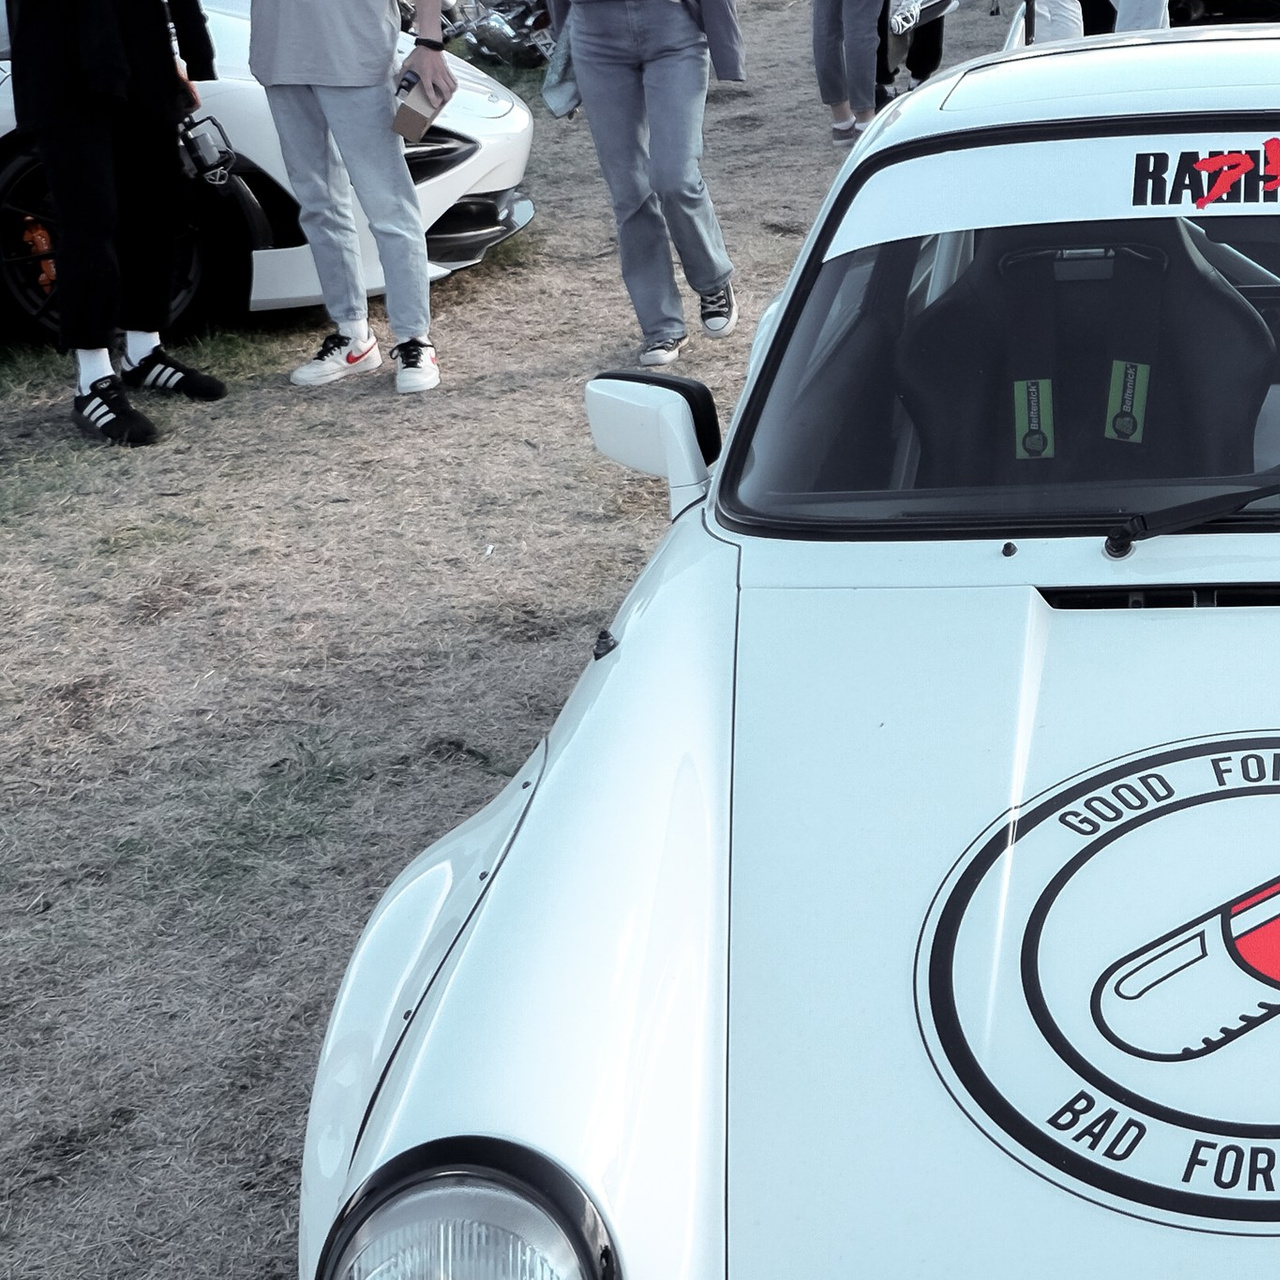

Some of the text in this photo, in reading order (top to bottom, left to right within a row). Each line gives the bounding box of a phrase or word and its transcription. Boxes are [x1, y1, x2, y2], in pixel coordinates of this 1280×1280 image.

[1058, 773, 1176, 837] GOOD
[1046, 1090, 1147, 1163] BAD
[1182, 1140, 1276, 1192] FOR
